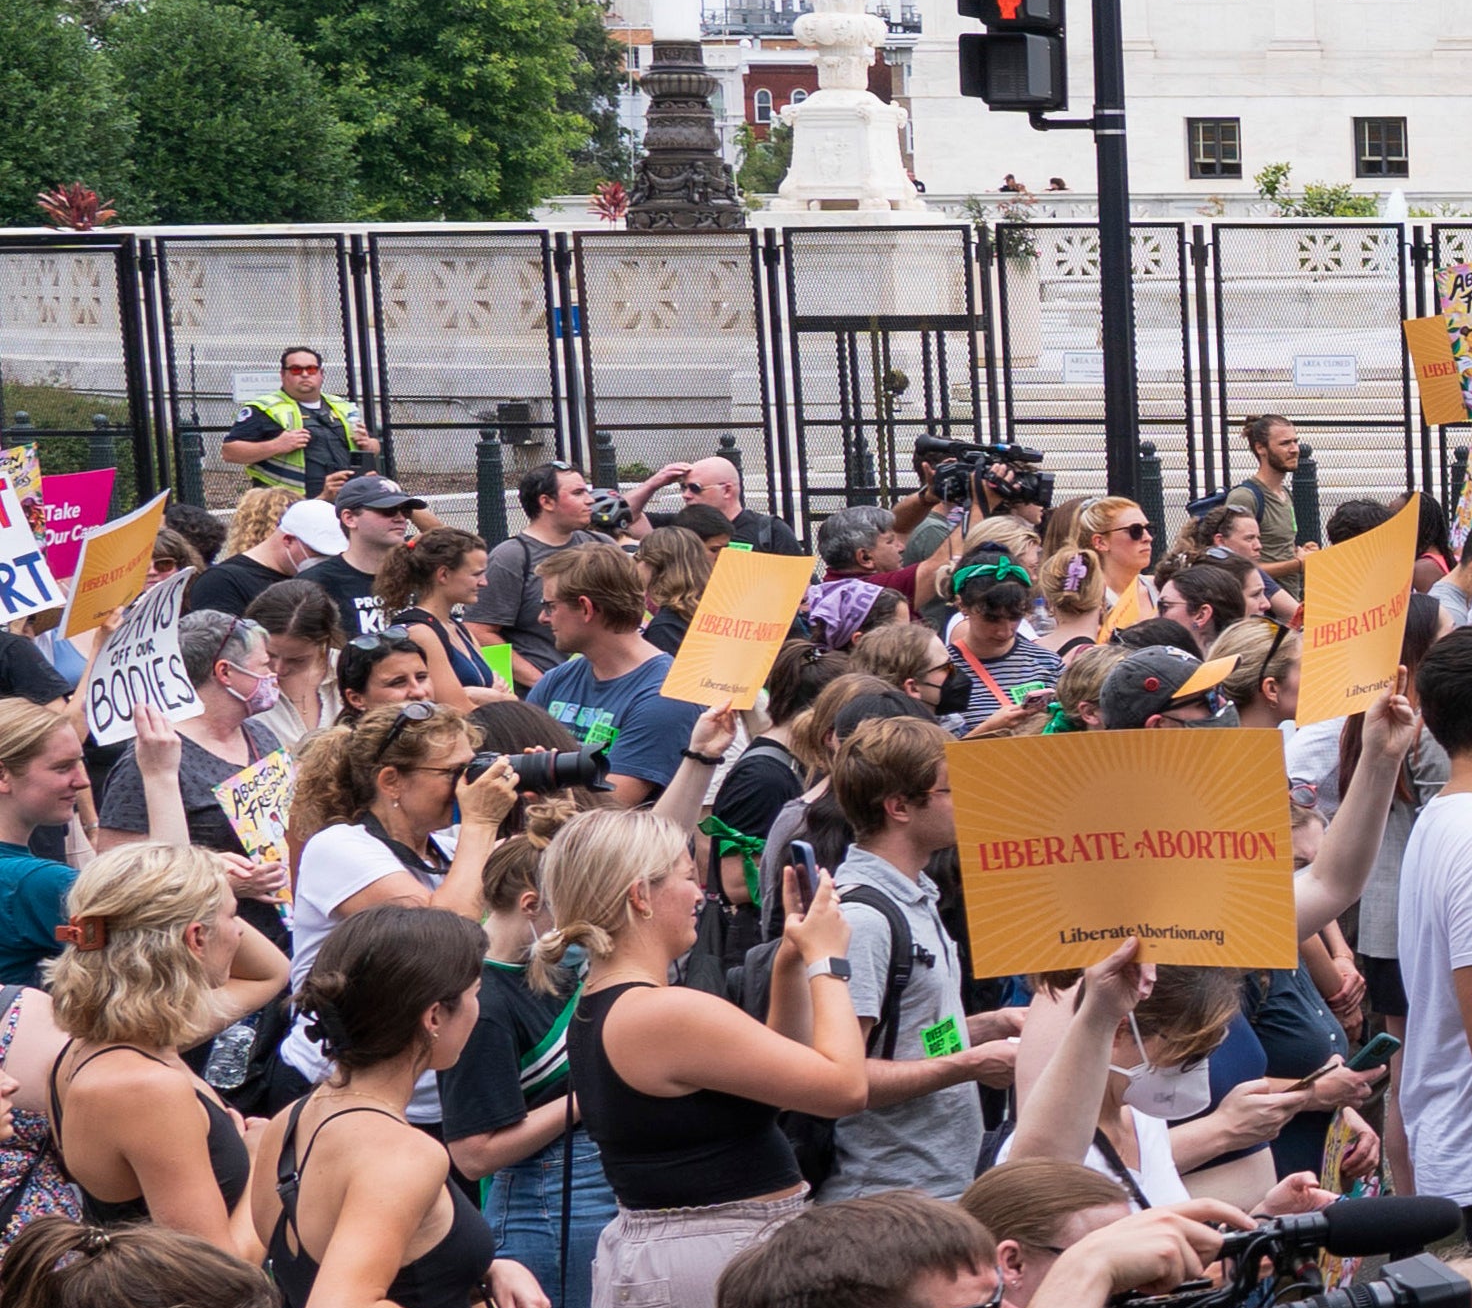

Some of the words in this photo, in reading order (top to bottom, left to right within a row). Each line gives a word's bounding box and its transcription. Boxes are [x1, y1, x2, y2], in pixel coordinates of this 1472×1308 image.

[1423, 360, 1458, 379] LIBE
[44, 503, 81, 521] Take
[82, 565, 125, 594] LIBERATE
[697, 613, 752, 639] LIBERATE
[1313, 604, 1388, 648] LIBERATE
[110, 645, 131, 667] OFF
[135, 638, 155, 658] OUR
[91, 654, 196, 733] BODIES
[232, 761, 281, 820] ABORTION
[246, 770, 290, 829] FREEDOM
[979, 832, 1129, 872] LIBERATE
[1134, 829, 1277, 861] ABORTION
[1059, 924, 1225, 946] LiberateAbortion.org
